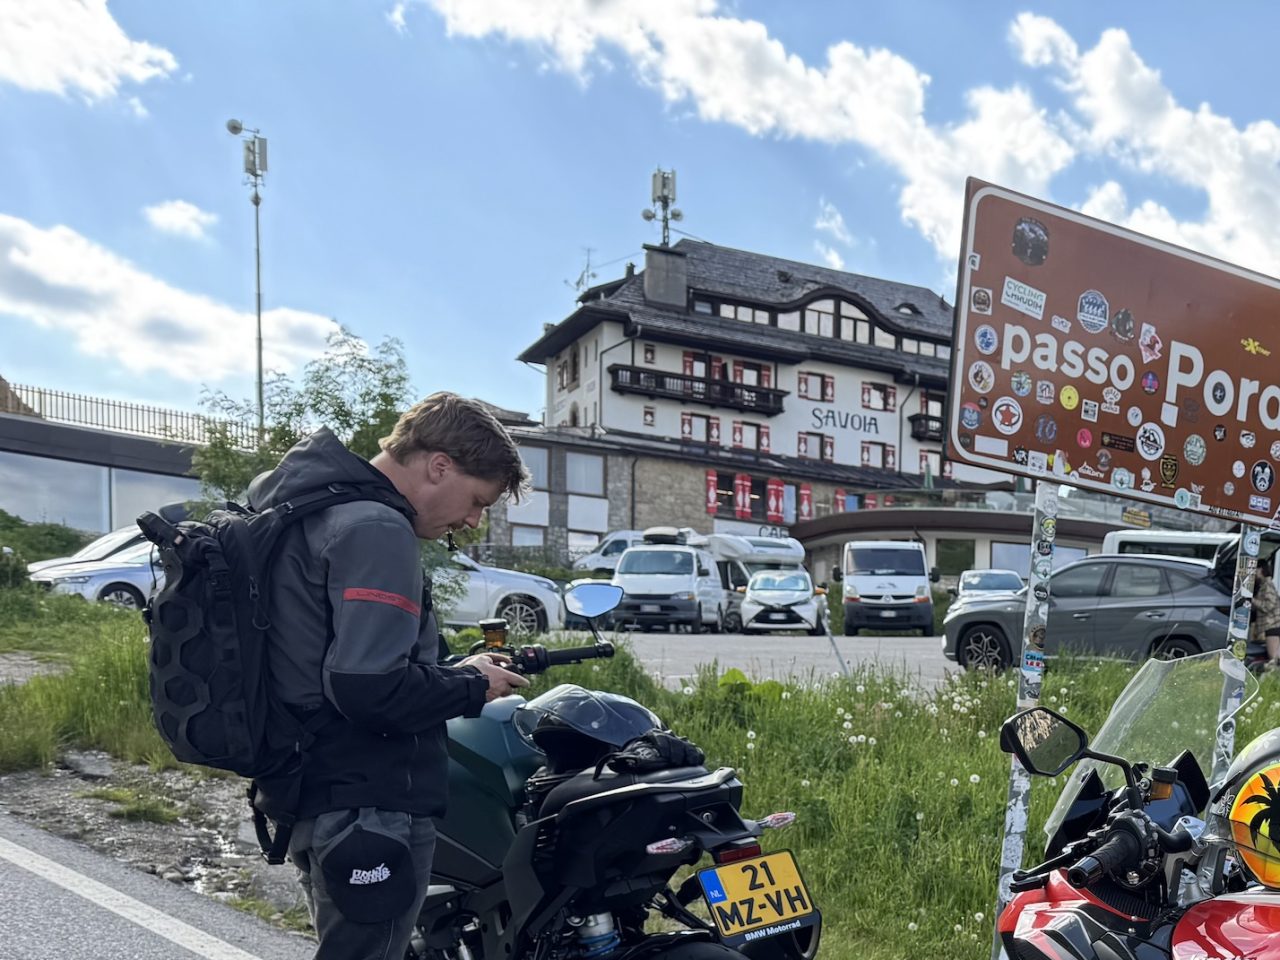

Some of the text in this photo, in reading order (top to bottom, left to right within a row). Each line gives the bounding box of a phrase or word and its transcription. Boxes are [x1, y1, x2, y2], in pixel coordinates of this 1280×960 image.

[1006, 280, 1044, 301] CYCLING
[1001, 323, 1135, 391] passo
[811, 407, 880, 434] SAVOIA
[759, 525, 789, 538] CAF
[741, 861, 776, 891] 21
[710, 889, 722, 898] NL
[716, 885, 808, 931] MZ-VH
[745, 920, 801, 941] BMW Motorrad
